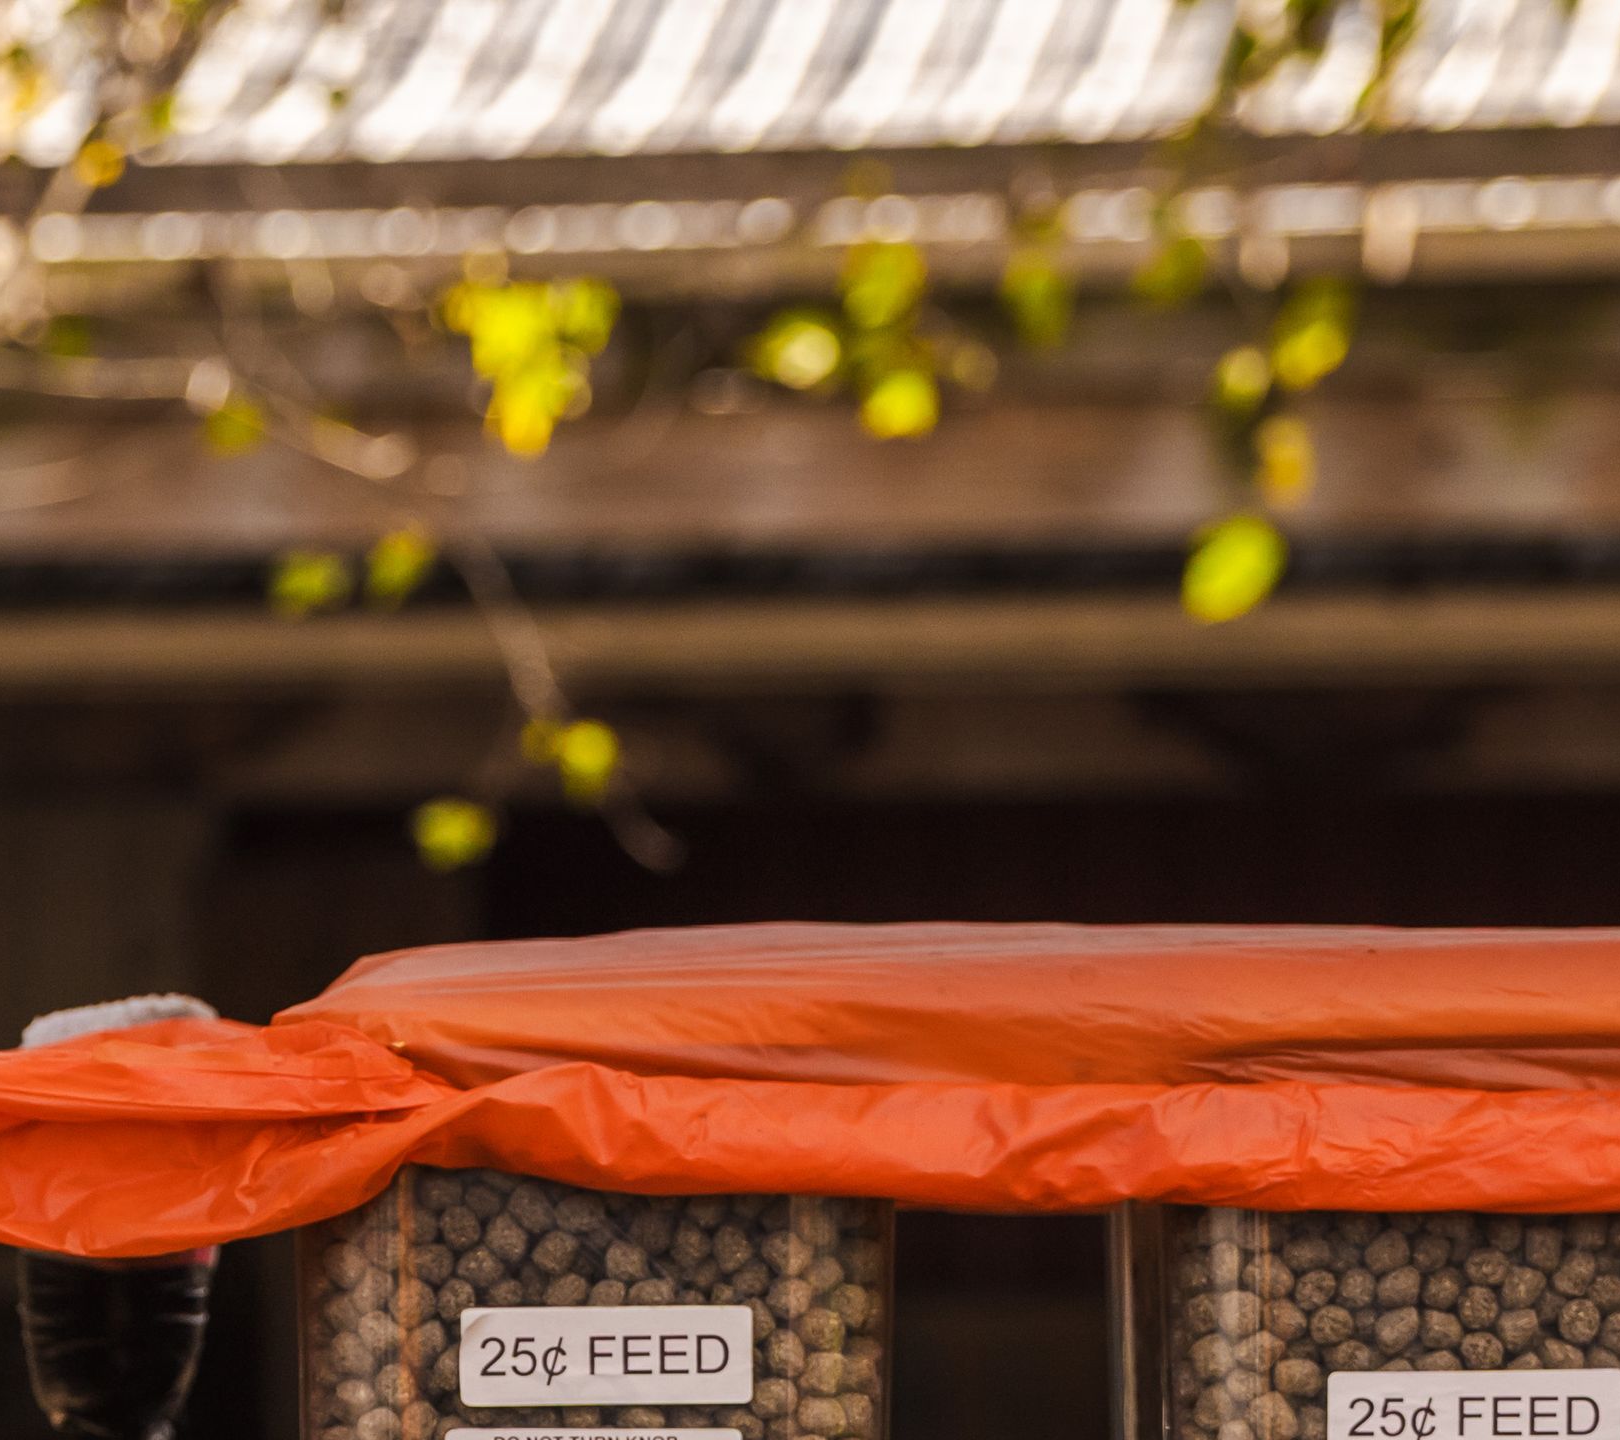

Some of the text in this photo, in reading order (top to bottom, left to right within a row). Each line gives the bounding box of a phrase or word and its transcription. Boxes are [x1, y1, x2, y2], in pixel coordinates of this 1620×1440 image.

[479, 1334, 730, 1387] 25¢ FEED
[1458, 1396, 1601, 1437] FEED
